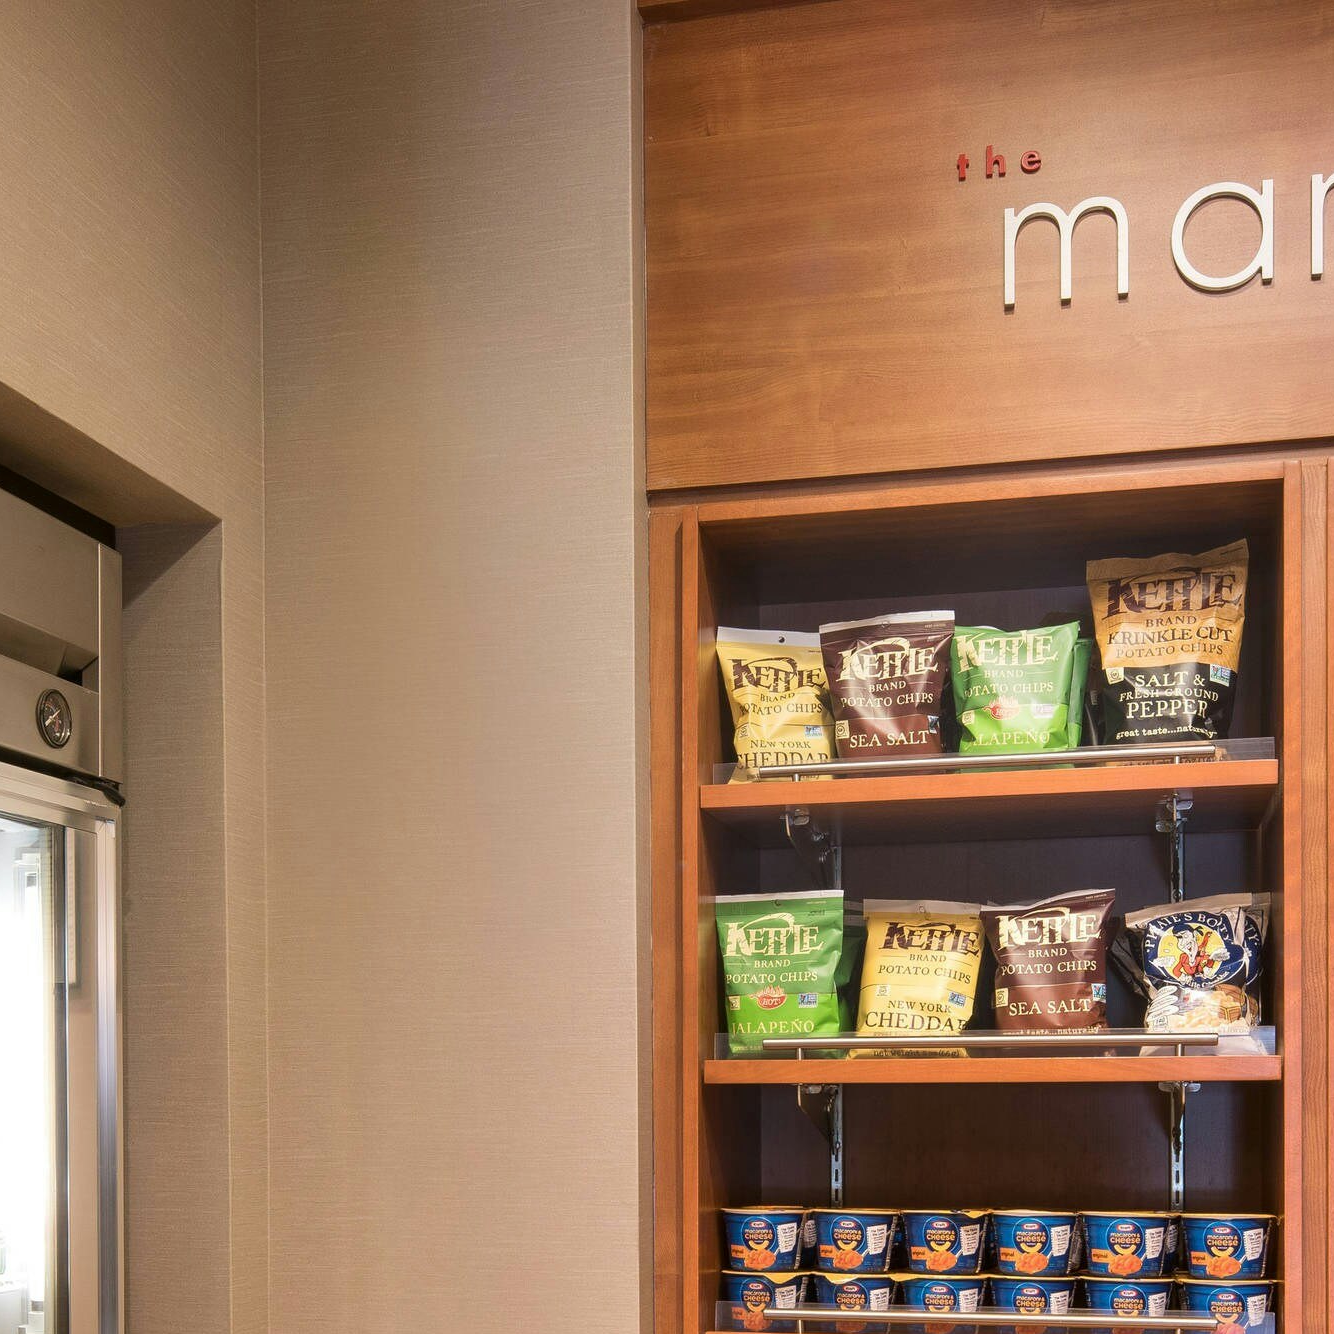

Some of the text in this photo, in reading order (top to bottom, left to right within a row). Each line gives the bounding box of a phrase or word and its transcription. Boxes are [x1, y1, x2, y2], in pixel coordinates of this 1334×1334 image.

[955, 145, 1043, 181] the
[1104, 567, 1243, 620] KETTLE
[1146, 616, 1197, 627] BRAND
[1106, 626, 1234, 646] KRINKLE CUT
[1116, 642, 1224, 659] POTATO CHIPS
[836, 637, 938, 683] KETTLE
[727, 657, 826, 693] KETTLE
[1135, 672, 1205, 687] SALT &
[841, 693, 933, 707] POTATO CHIPS
[1119, 686, 1219, 703] FRESH GROUND
[1126, 700, 1208, 720] PEPPER
[750, 739, 811, 749] NEW YORK
[849, 729, 930, 748] SEA SALT
[723, 913, 824, 957] KETTLE
[726, 971, 818, 984] POTATO CHIPS
[732, 1017, 815, 1035] JALAPEÑO
